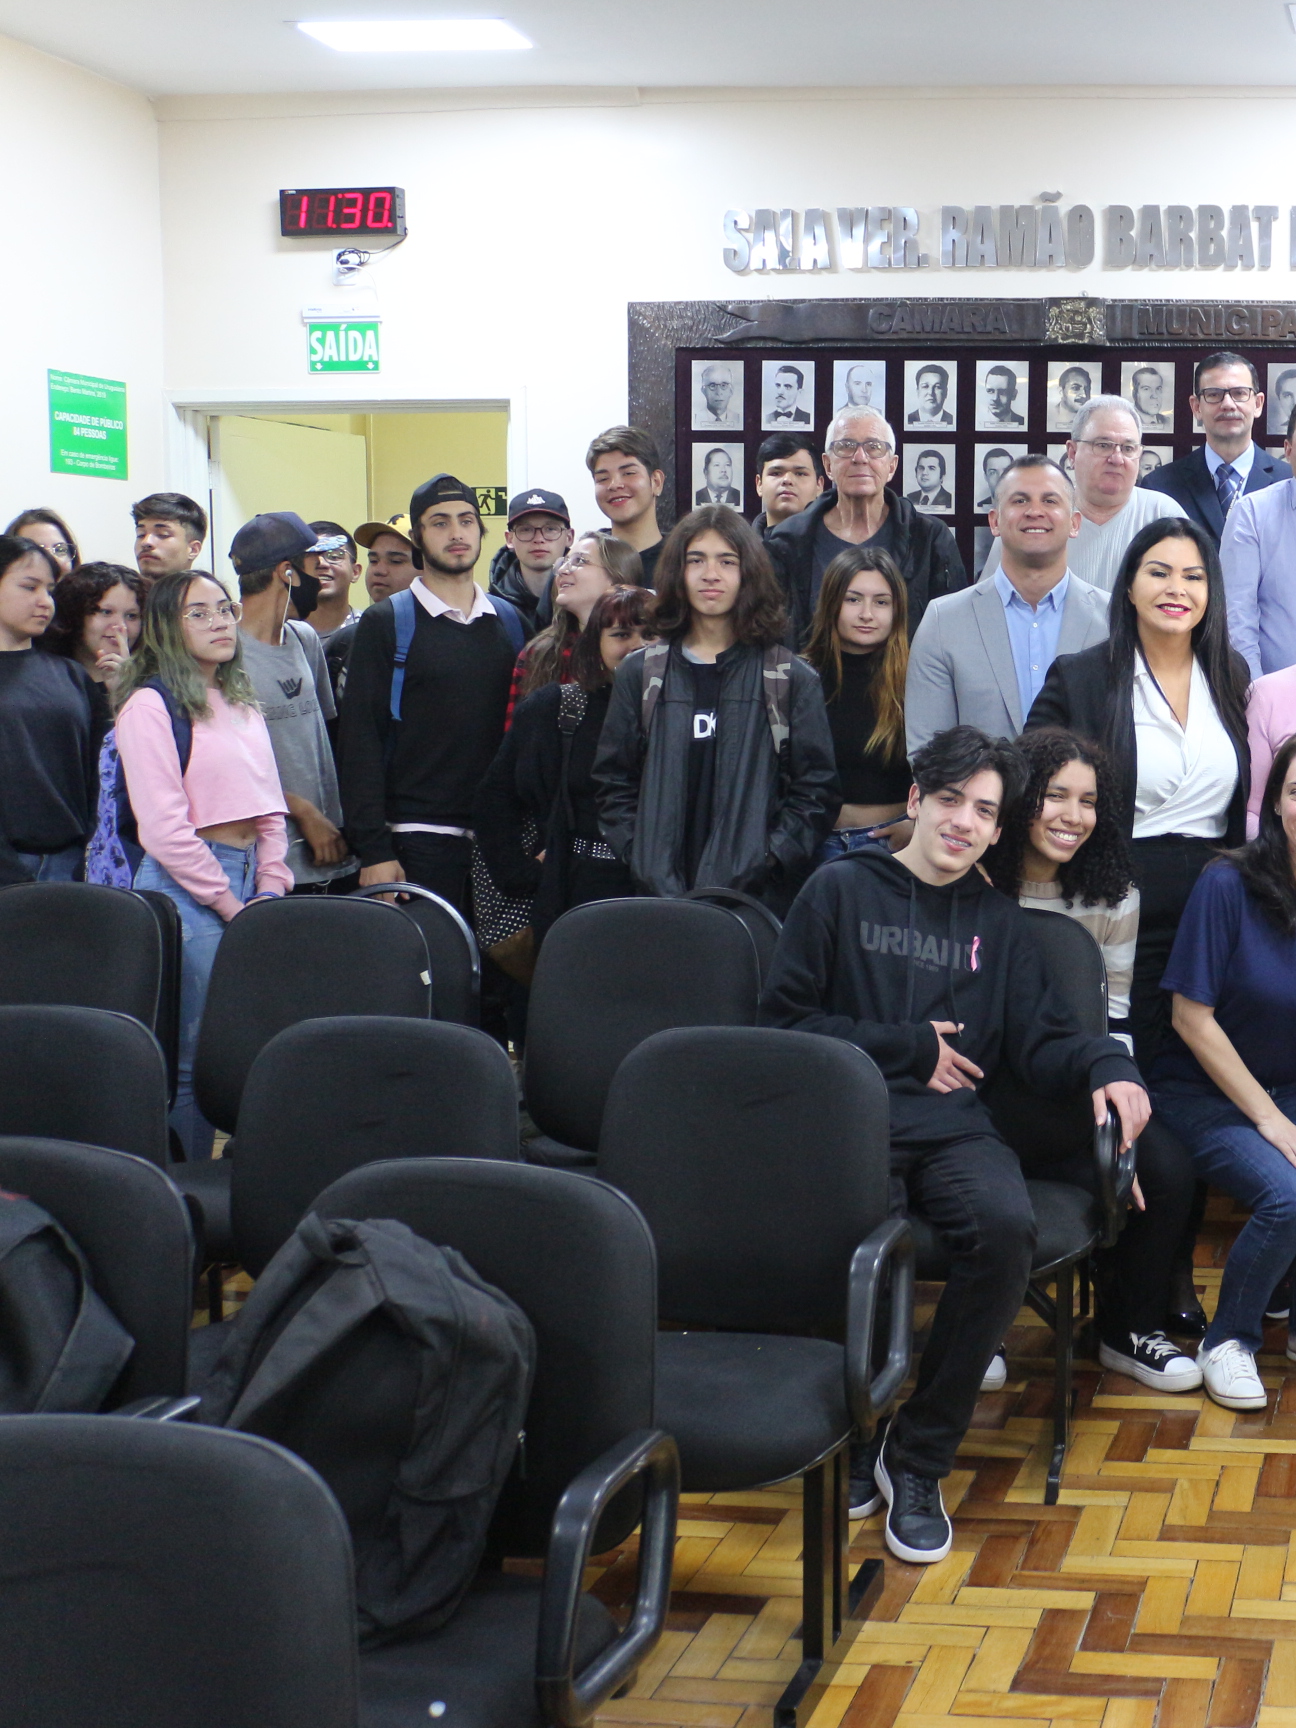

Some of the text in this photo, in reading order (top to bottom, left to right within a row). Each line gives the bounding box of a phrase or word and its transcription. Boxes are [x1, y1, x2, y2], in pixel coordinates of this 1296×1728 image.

[836, 206, 929, 269] VER.
[940, 190, 1096, 269] RAMÃO
[1107, 204, 1279, 268] BARBAT
[310, 323, 379, 362] SAÍDA
[54, 411, 124, 430] CAPACIDADE DE PÚBLICO
[81, 427, 107, 440] PESSOAS
